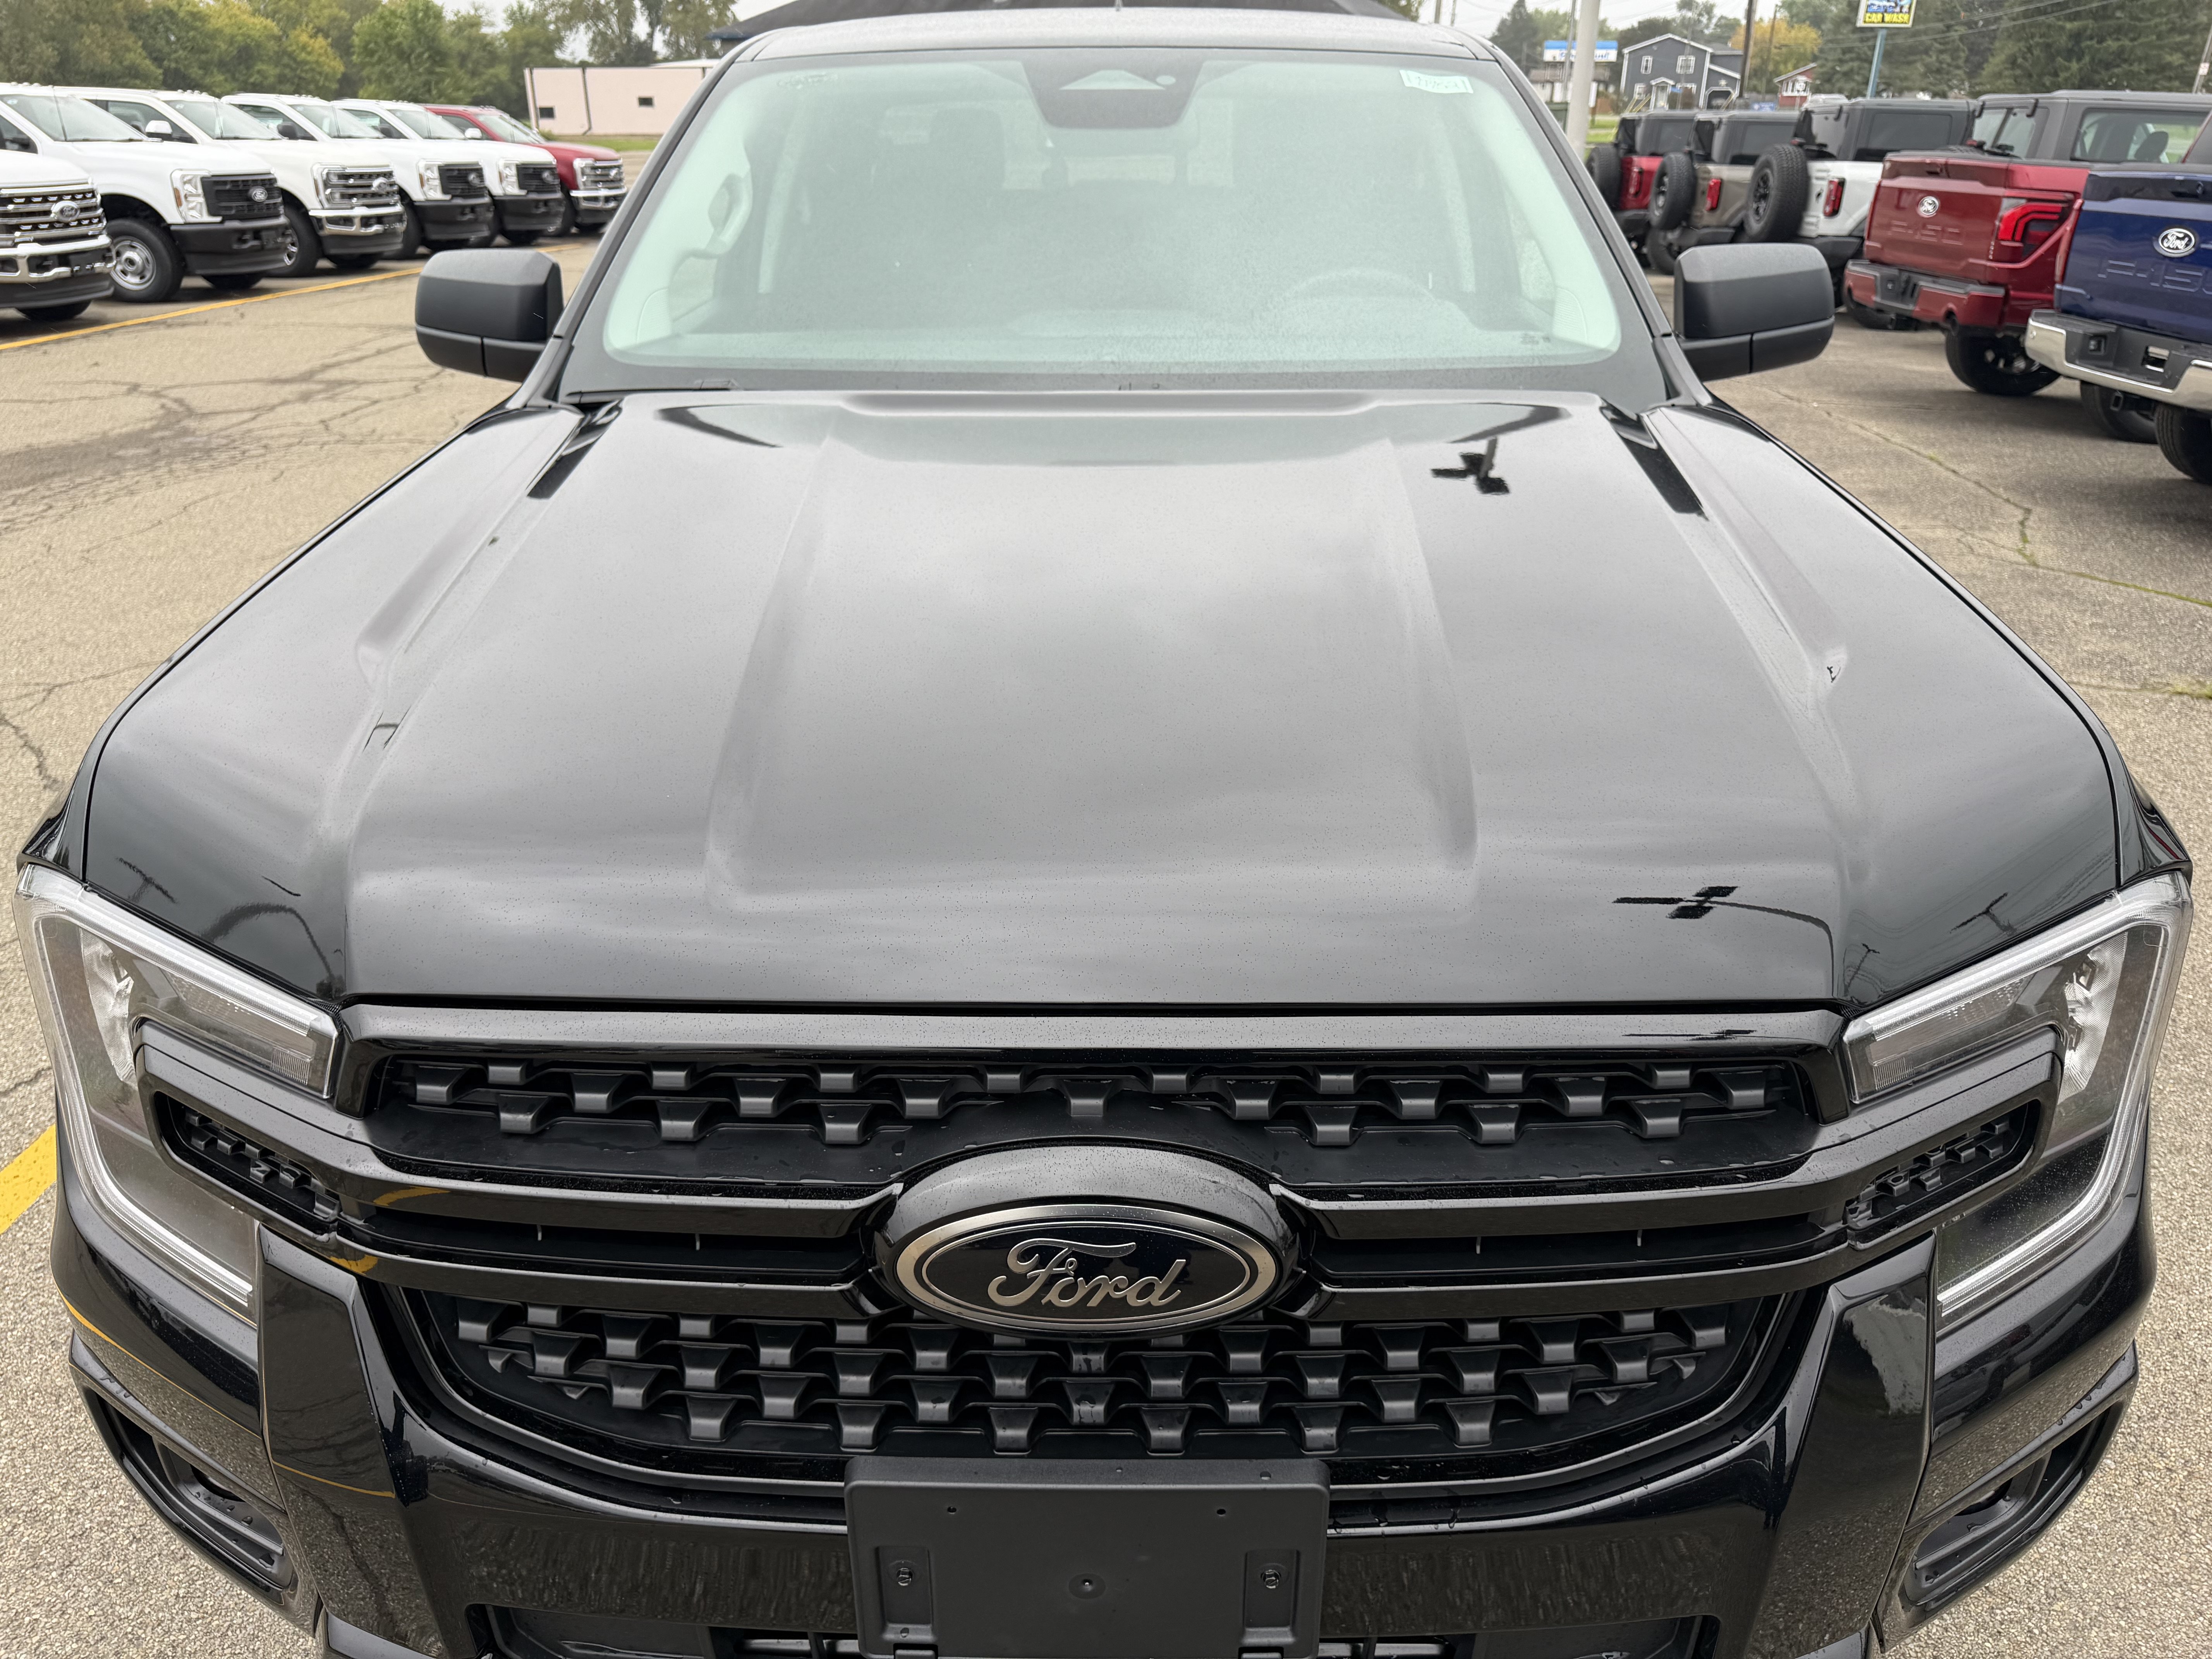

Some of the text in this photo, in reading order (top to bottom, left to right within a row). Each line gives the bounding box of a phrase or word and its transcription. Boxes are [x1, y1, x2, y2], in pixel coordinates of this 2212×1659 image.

[1865, 13, 1910, 24] CAR WASH
[2164, 232, 2189, 250] Ford
[988, 1238, 1185, 1306] Ford
